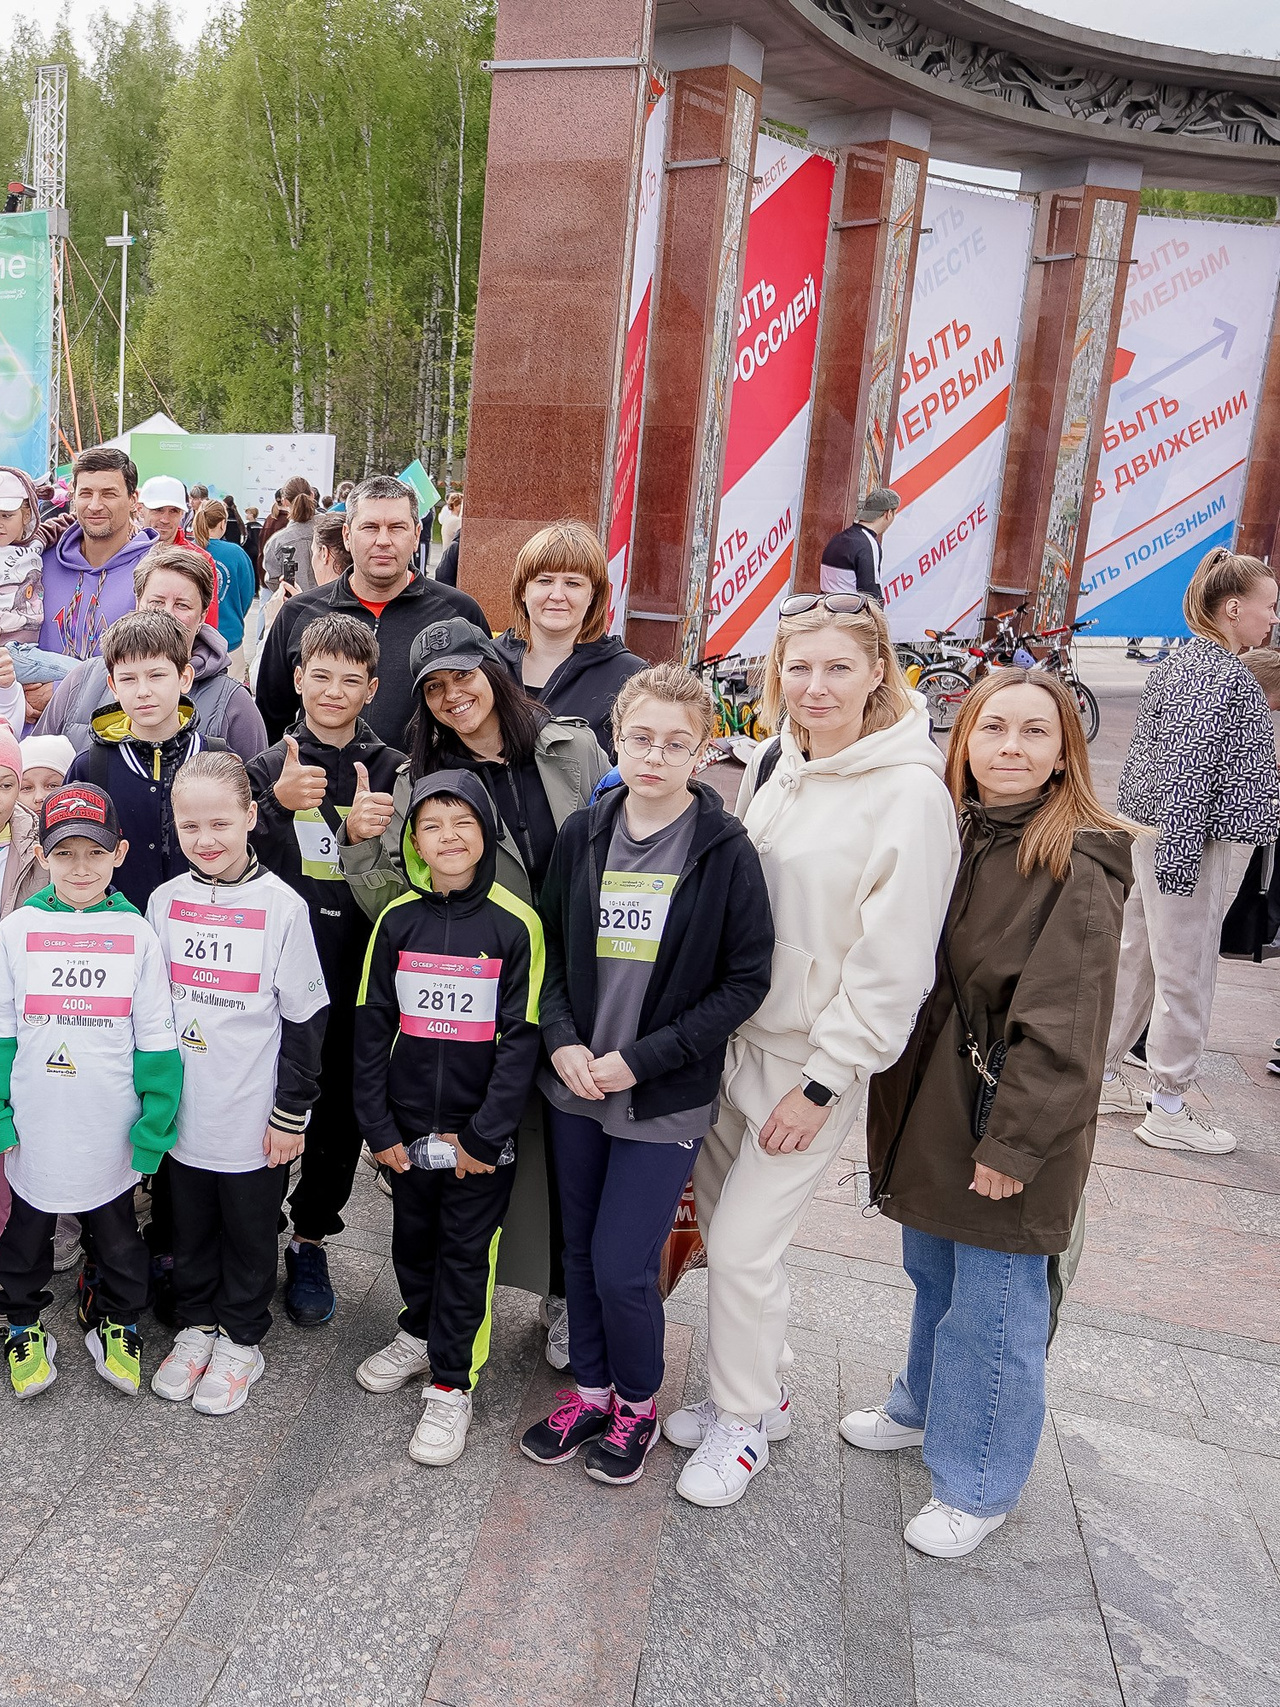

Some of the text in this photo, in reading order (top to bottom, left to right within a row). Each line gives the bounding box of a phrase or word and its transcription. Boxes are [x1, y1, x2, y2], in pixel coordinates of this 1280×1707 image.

[1102, 395, 1181, 454] БЫТЬ
[1114, 389, 1249, 494] ДВИЖЕНИИ
[918, 500, 988, 577] ВМЕСТЕ
[1124, 494, 1227, 571] ПОЛЕЗНЫМ
[420, 626, 451, 660] 13
[600, 908, 652, 930] 3205
[184, 938, 233, 963] 2611
[51, 967, 107, 988] 2609
[417, 989, 474, 1014] 2812
